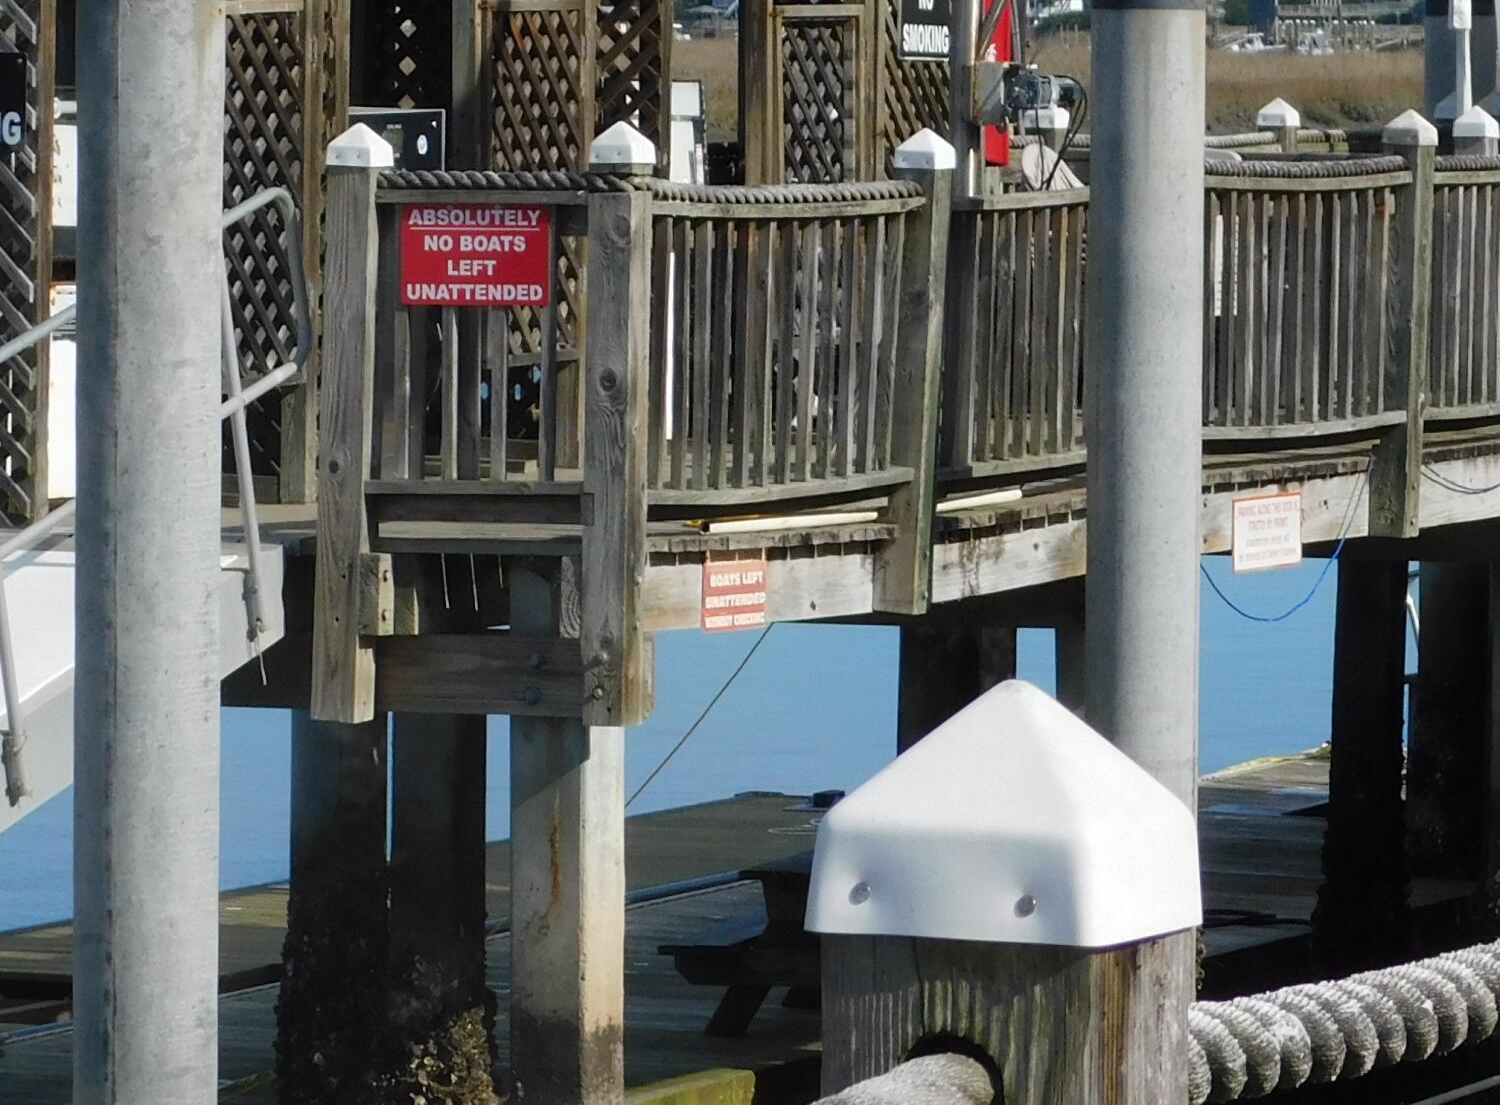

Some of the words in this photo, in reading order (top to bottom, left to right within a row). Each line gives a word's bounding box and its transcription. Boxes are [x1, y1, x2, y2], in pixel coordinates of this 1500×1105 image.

[902, 23, 950, 54] SMOKING
[408, 208, 541, 226] ABSOLUTELY
[424, 235, 453, 252] NO
[459, 235, 526, 253] BOATS
[447, 259, 497, 276] LEFT
[406, 283, 544, 301] UNATTENDED
[709, 572, 741, 588] BOATS
[742, 571, 764, 585] LEFT
